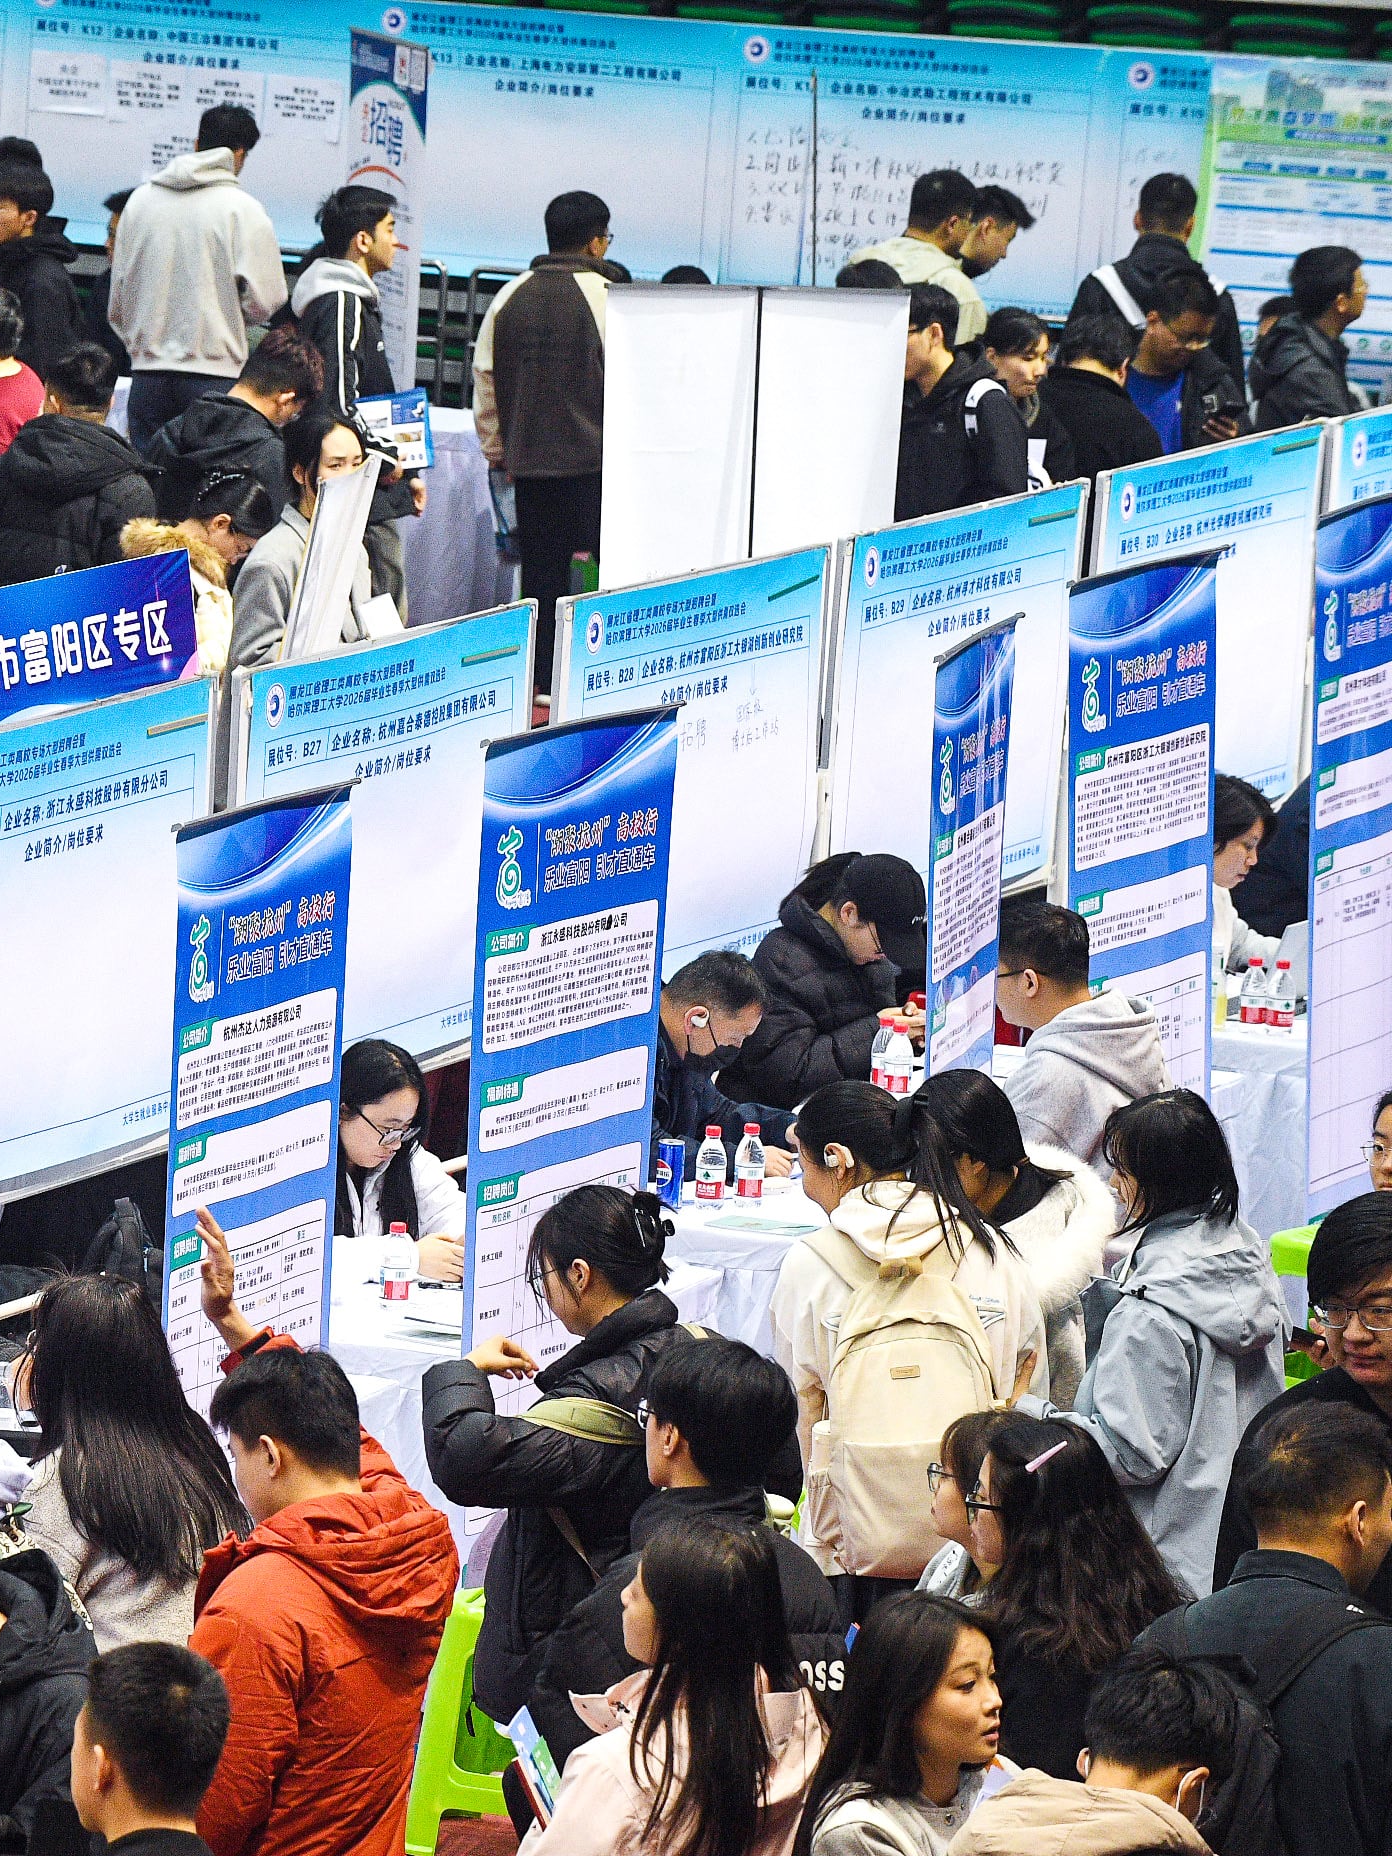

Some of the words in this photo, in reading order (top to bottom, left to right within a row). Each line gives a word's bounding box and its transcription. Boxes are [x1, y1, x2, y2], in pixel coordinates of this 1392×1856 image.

[927, 607, 991, 637] 企业简介/岗位要求
[586, 670, 634, 692] 展位号：B28
[267, 740, 322, 768] 展位号：B27
[355, 745, 432, 777] 企业简介/岗位要求
[24, 824, 104, 863] 企业简介/岗位要求
[545, 815, 611, 857] “潮聚杭州”
[616, 808, 659, 843] 高校行
[543, 858, 591, 893] 乐业富阳
[596, 843, 656, 880] 引才直通车
[228, 899, 292, 946] “潮聚杭州”
[297, 891, 336, 928] 高校行
[490, 932, 525, 951] 公司简介
[540, 912, 628, 948] 浙江永盛科技股份有限公司
[225, 946, 275, 985] 乐业富阳
[278, 928, 333, 969] 引才直通车
[483, 1179, 516, 1199] 招聘岗位
